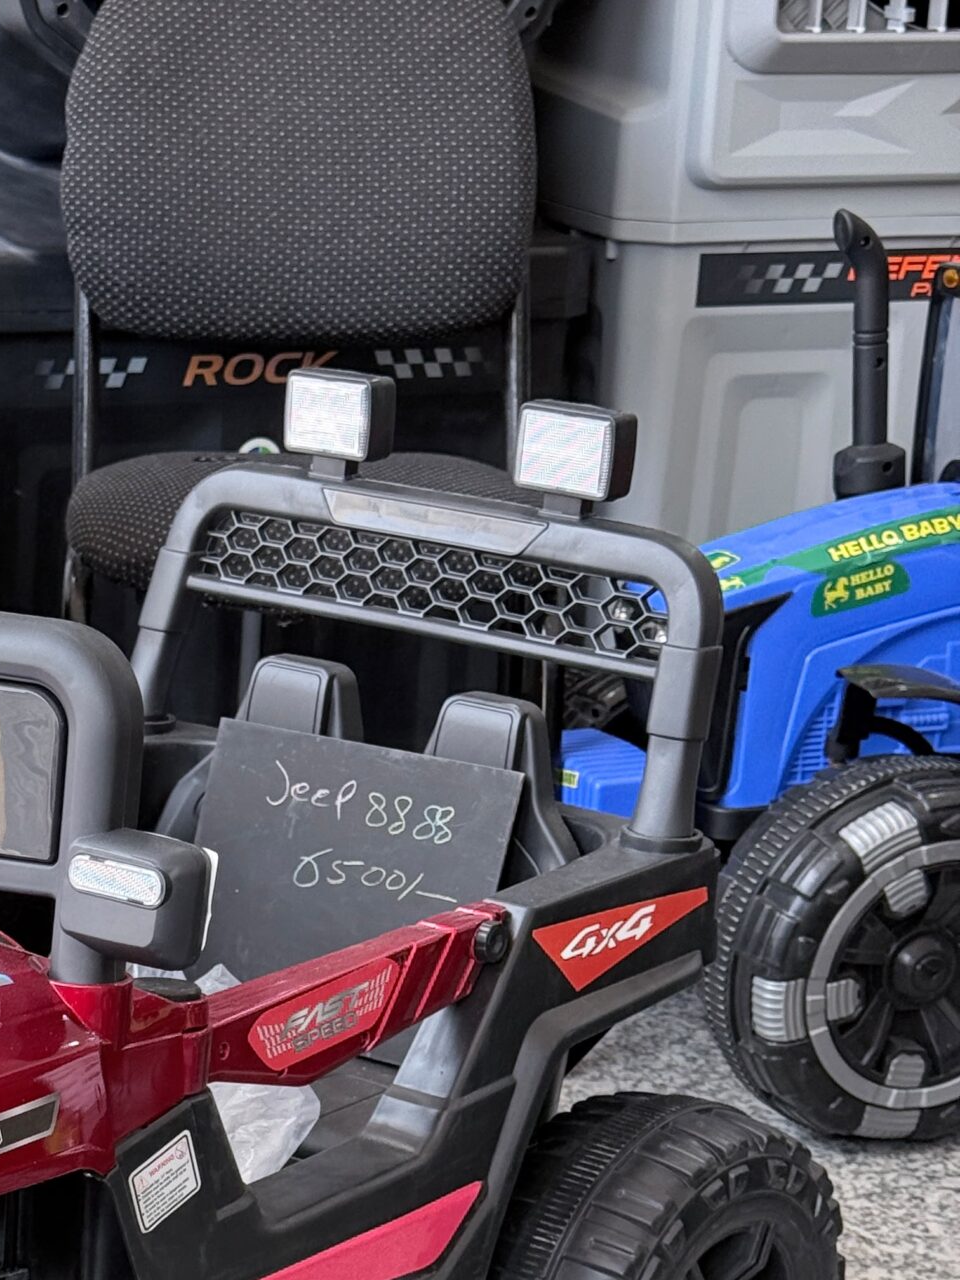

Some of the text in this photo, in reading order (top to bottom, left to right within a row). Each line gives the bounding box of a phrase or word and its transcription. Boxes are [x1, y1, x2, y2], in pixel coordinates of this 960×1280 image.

[828, 530, 900, 562] HELLO
[850, 564, 894, 586] HELLO
[855, 580, 893, 600] BABY
[365, 792, 455, 844] 8888
[280, 981, 370, 1041] FAST
[293, 1011, 359, 1053] SPEED
